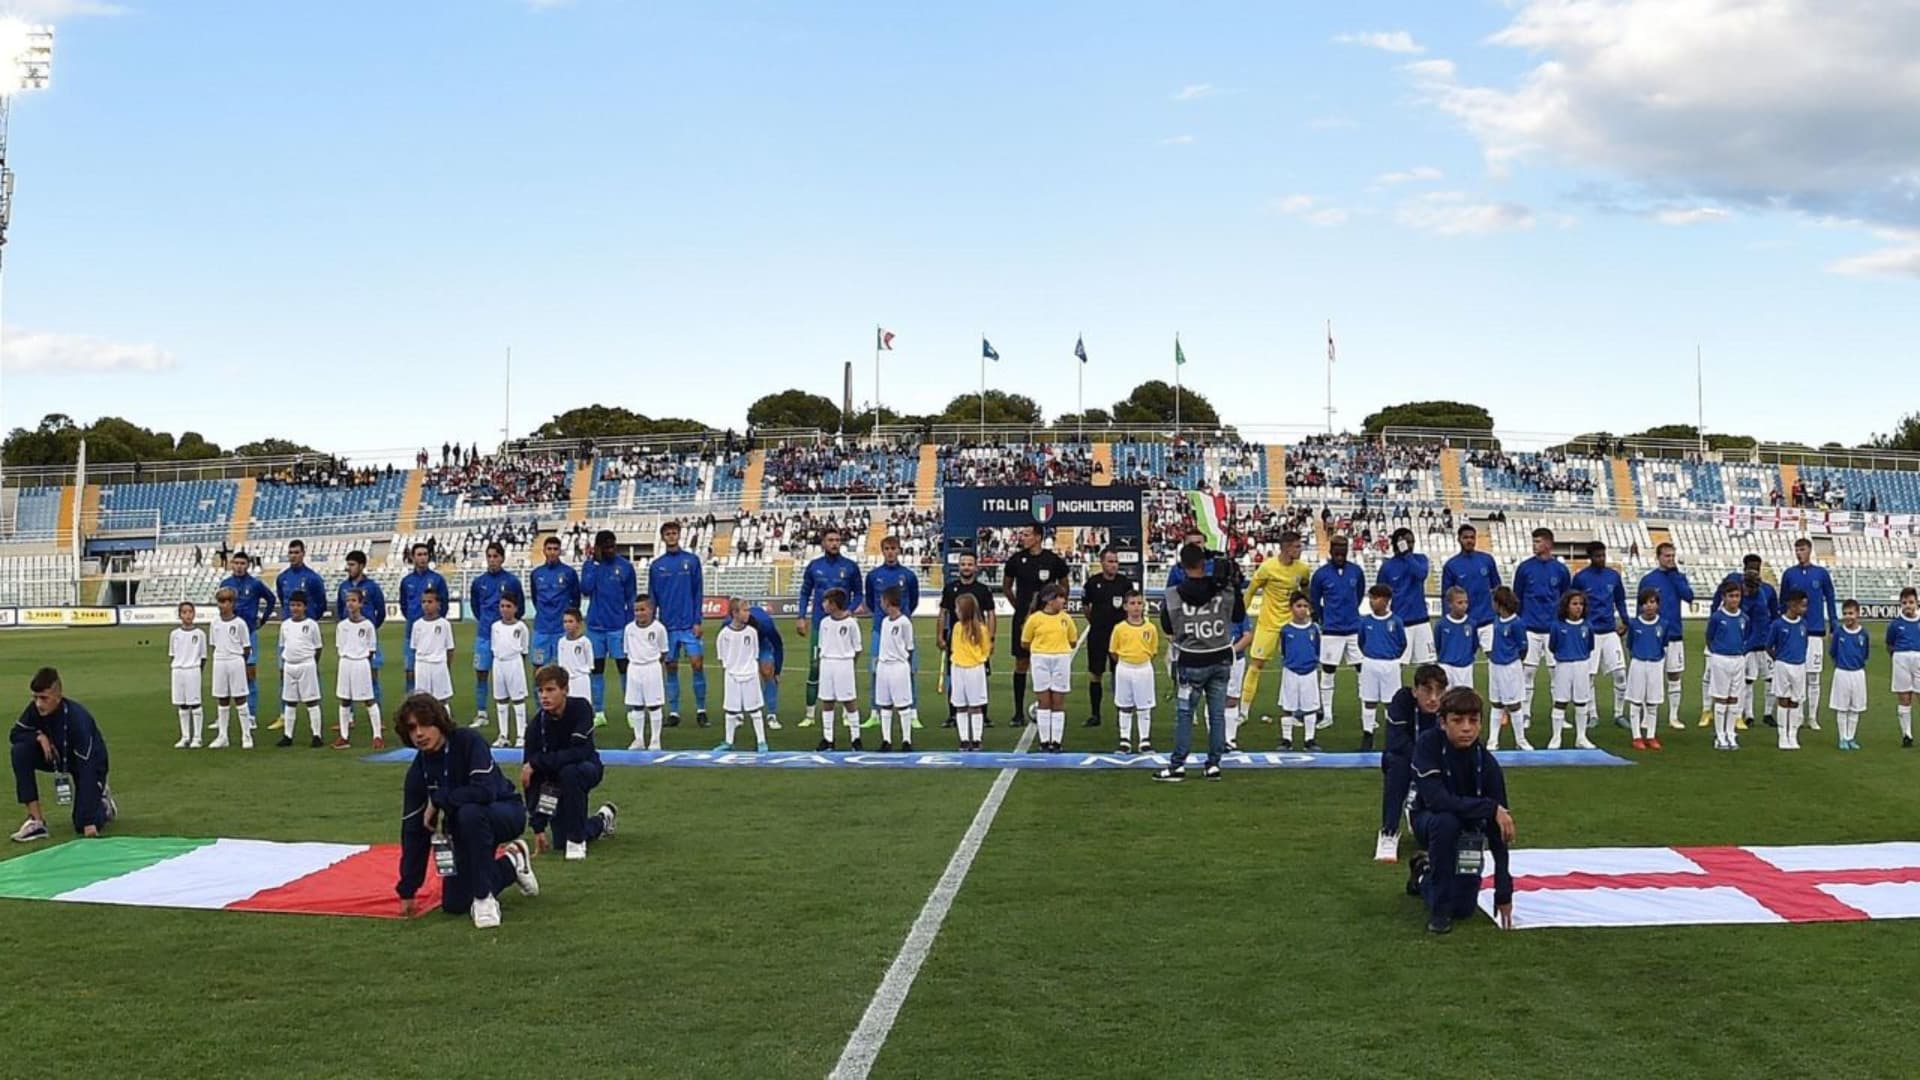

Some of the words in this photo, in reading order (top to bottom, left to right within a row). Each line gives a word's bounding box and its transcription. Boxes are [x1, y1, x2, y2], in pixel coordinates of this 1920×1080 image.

[982, 498, 1029, 512] ITALIA
[1056, 500, 1135, 513] INGHILTERRA
[1184, 620, 1225, 639] FIGC
[651, 752, 963, 764] PEACE
